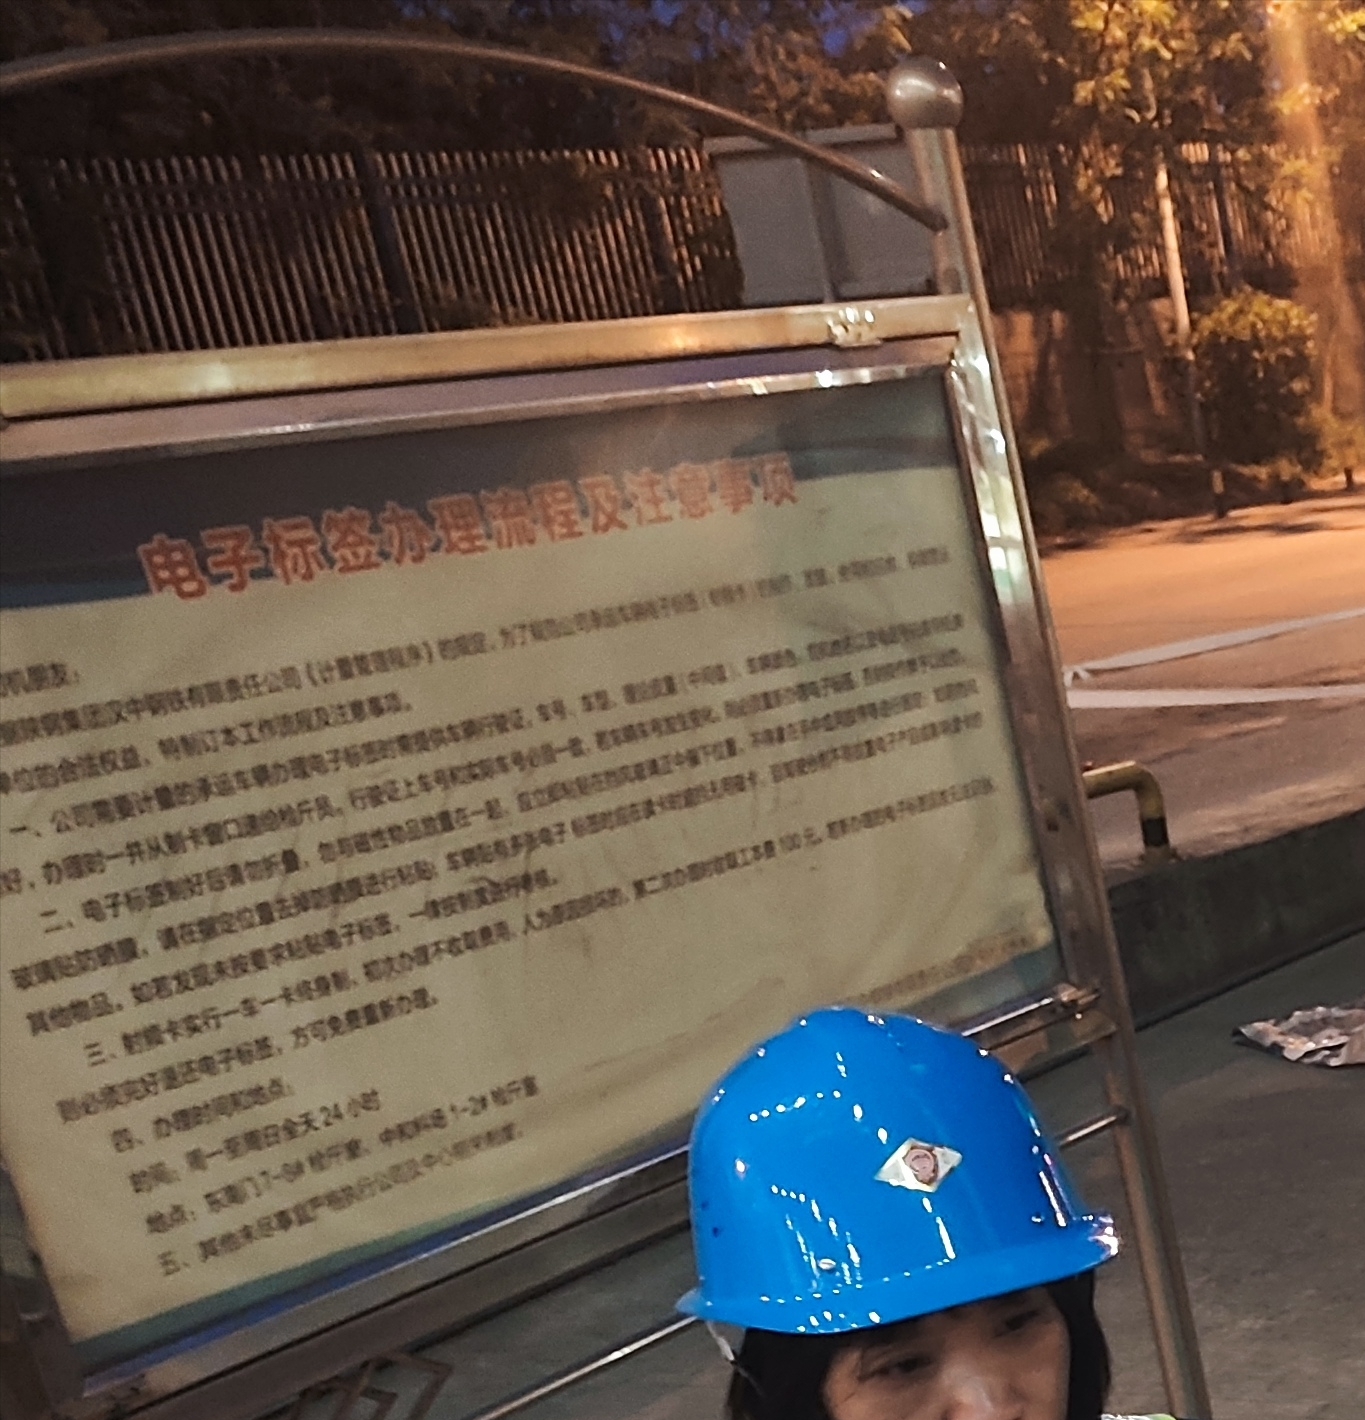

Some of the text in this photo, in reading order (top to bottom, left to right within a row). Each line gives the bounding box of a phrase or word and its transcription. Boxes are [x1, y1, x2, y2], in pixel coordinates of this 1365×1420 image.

[137, 452, 798, 600] 电子标签办理流程及注意事项
